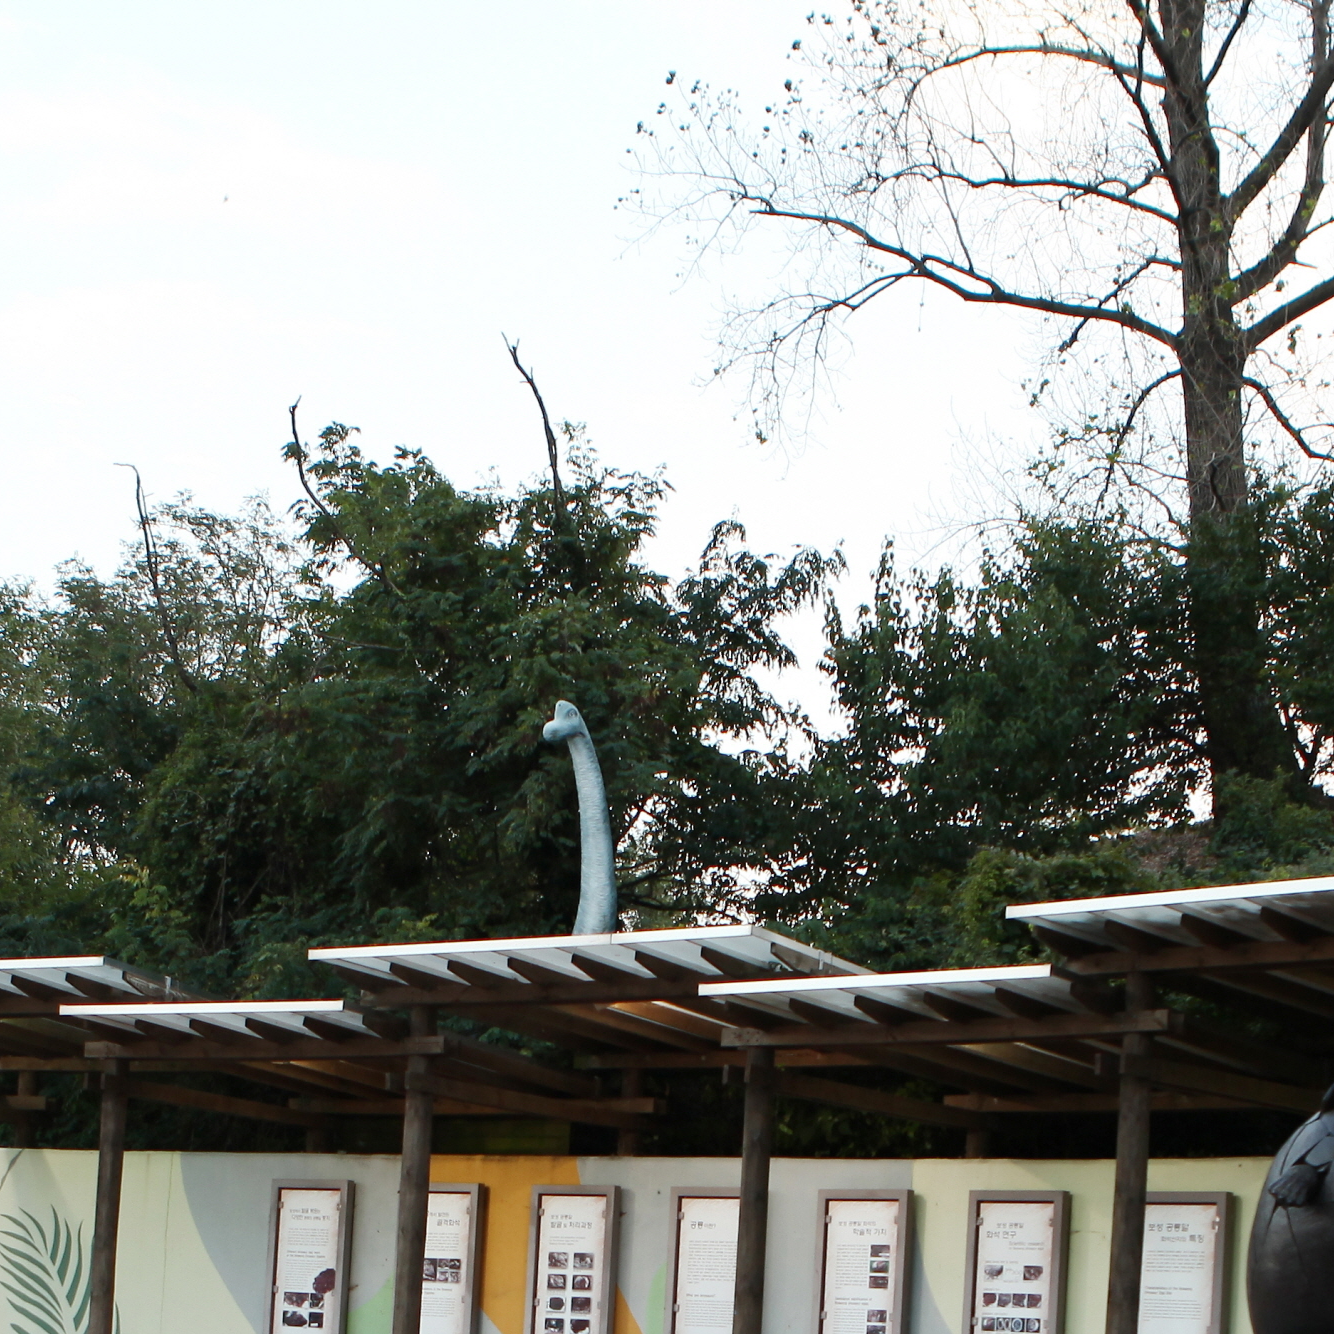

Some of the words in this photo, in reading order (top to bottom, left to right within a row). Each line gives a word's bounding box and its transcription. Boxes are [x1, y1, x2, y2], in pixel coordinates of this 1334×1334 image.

[569, 1221, 593, 1230] 처리과정
[1148, 1223, 1164, 1232] 보성
[1166, 1223, 1190, 1232] 공룡알
[852, 1228, 872, 1236] 학술적
[873, 1228, 887, 1236] 가치
[986, 1230, 1001, 1239] 화석
[1002, 1230, 1017, 1239] 연구
[1189, 1234, 1205, 1244] 특징
